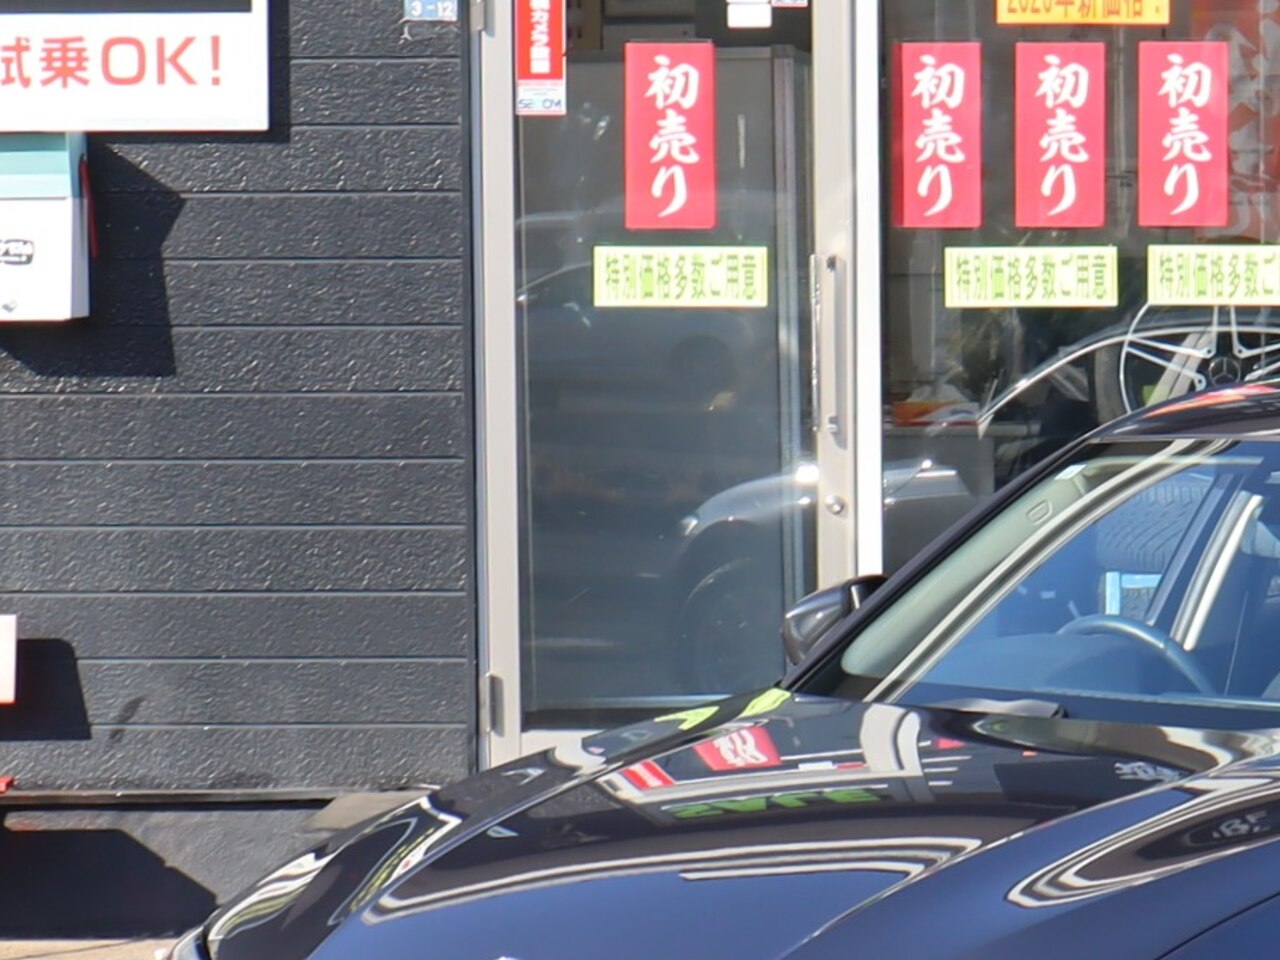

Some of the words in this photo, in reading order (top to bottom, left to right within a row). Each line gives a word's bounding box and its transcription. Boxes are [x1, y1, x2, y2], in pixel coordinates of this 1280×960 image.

[518, 99, 562, 109] SEOM
[645, 55, 700, 217] 初売り
[912, 54, 965, 216] 初売り
[1036, 54, 1089, 215] 初売り
[1158, 53, 1212, 214] 初売り
[606, 253, 757, 300] 特別価格多数ご用意
[957, 254, 1107, 300] 特別価格多数ご用意
